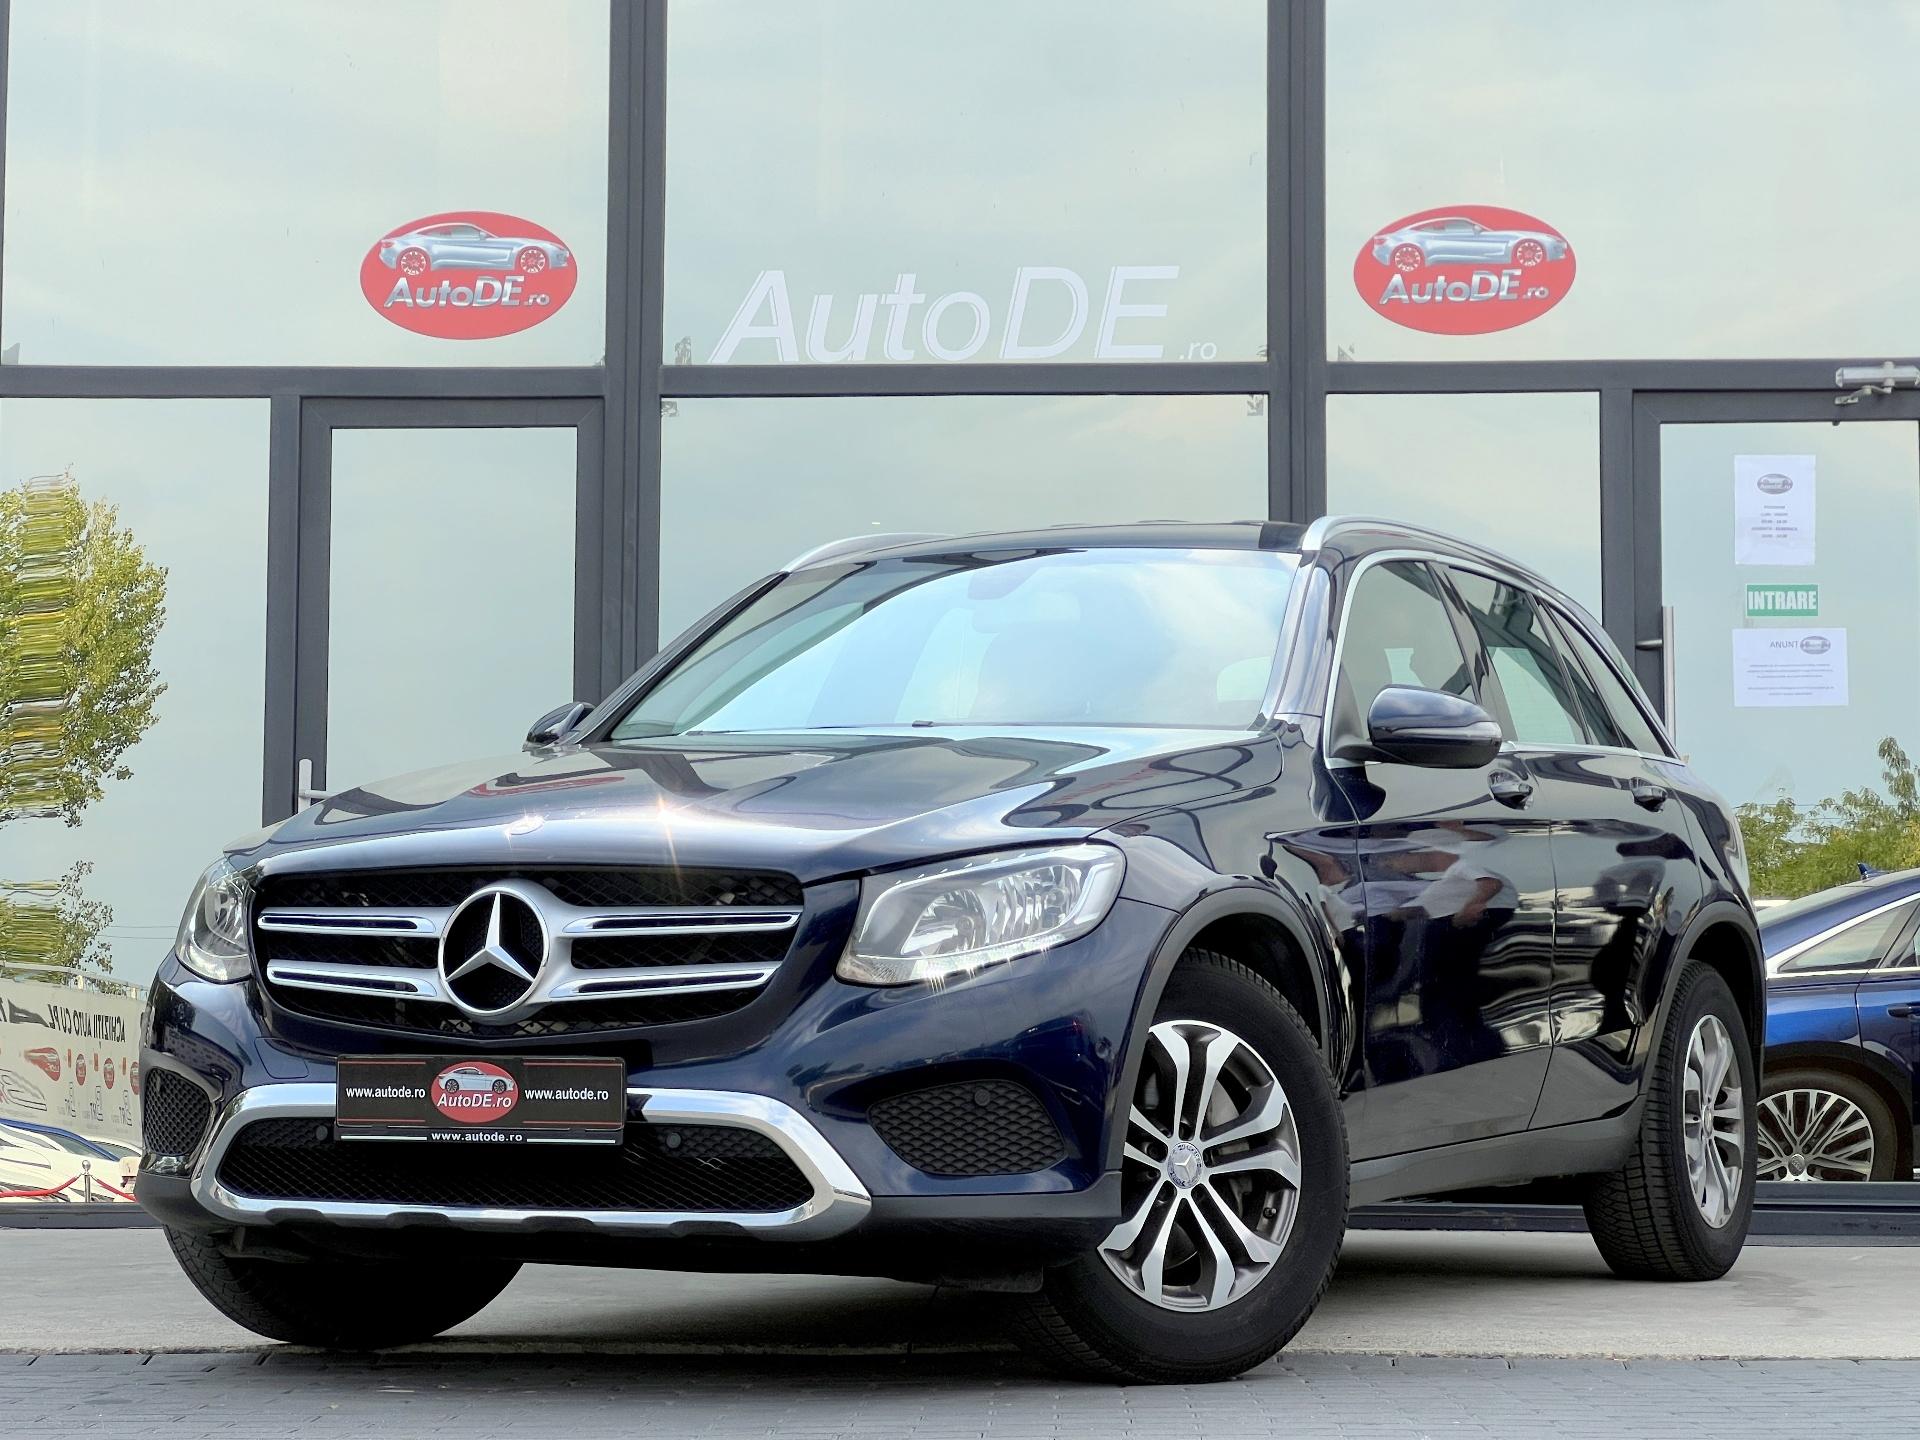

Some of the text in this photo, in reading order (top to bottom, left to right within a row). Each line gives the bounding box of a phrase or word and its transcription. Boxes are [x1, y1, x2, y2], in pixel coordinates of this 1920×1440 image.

[1748, 591, 1817, 610] INTRARE
[346, 1086, 426, 1098] www.autode.ro
[525, 1088, 609, 1100] www.autode.ro
[436, 1093, 512, 1109] AutoDE.ro
[431, 1131, 523, 1142] www.autode.ro
